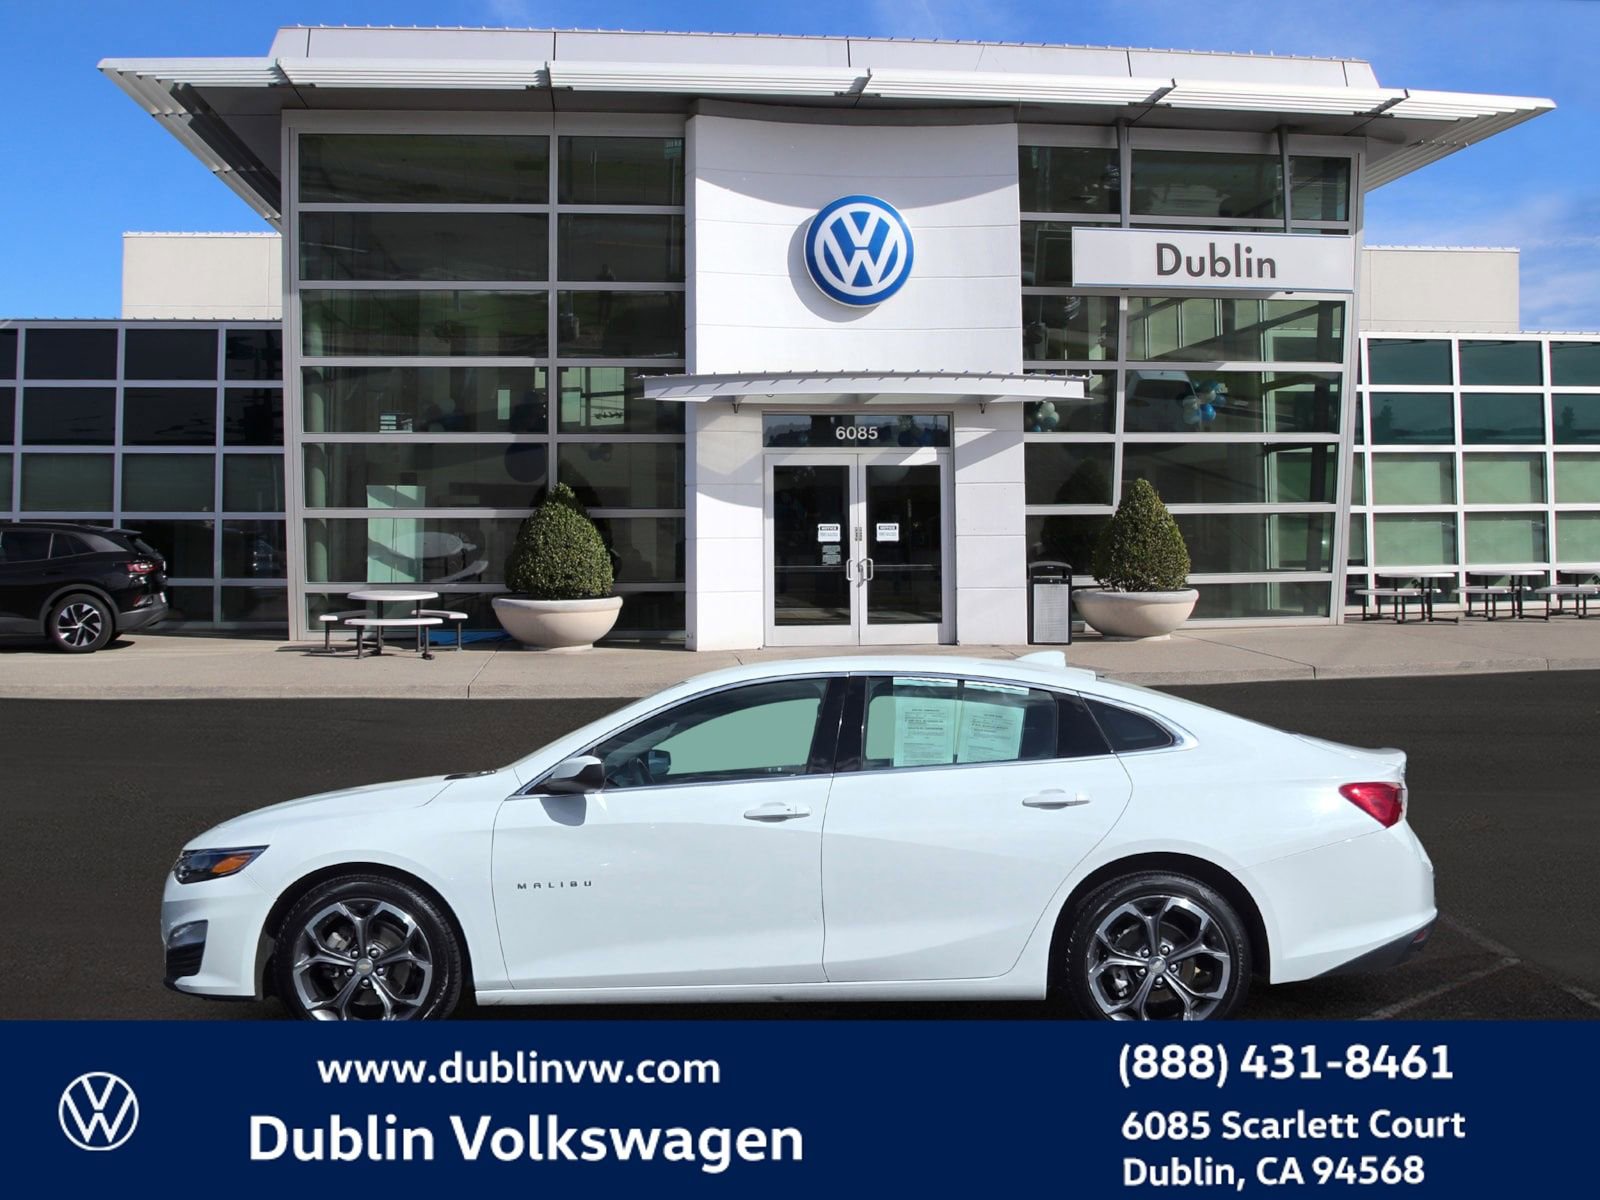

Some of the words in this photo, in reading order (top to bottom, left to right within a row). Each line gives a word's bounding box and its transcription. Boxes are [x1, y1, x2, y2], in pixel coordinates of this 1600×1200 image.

[1157, 243, 1276, 278] Dublin
[835, 426, 878, 440] 6085
[517, 880, 592, 890] MALIBU
